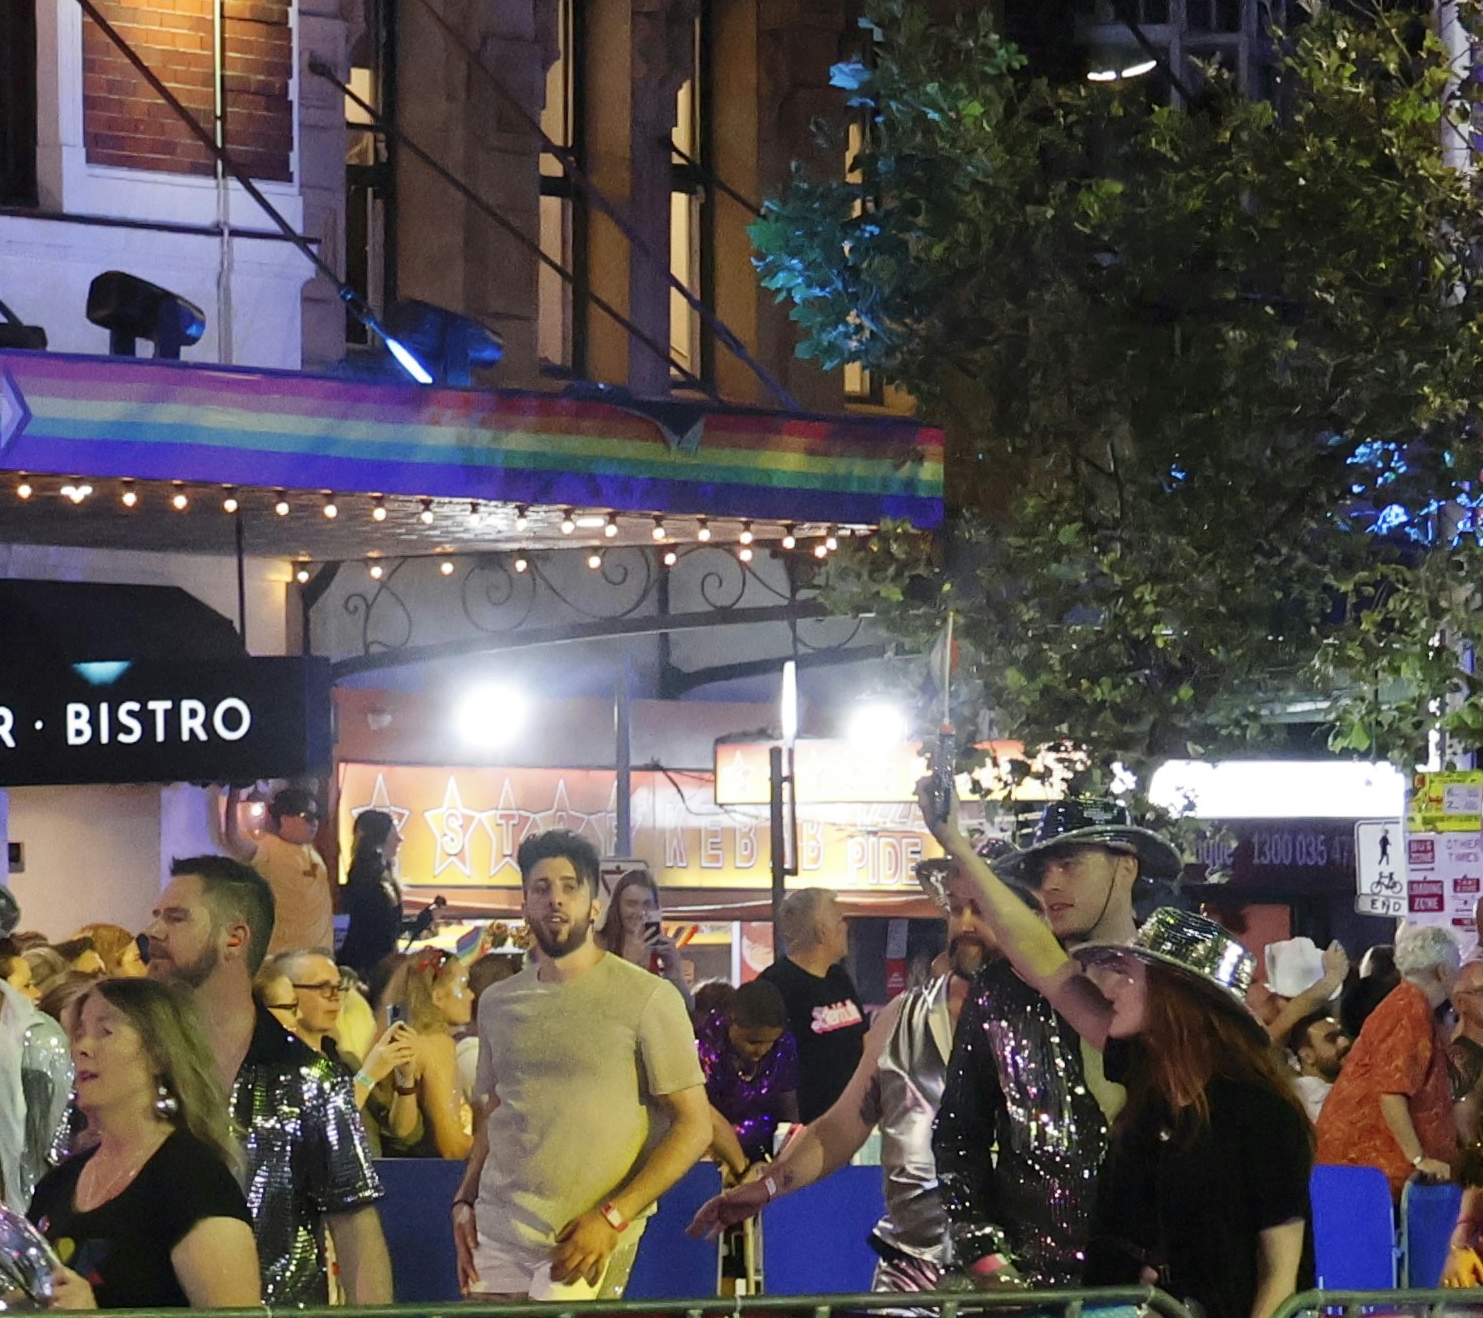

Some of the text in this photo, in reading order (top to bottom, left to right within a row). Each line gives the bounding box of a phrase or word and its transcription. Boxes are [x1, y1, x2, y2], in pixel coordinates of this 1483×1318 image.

[66, 697, 252, 745] BISTRO
[665, 803, 824, 870] KEBB
[846, 835, 923, 887] PIDE
[1251, 831, 1290, 866] 1300
[1295, 833, 1328, 866] 035
[1370, 897, 1402, 913] END
